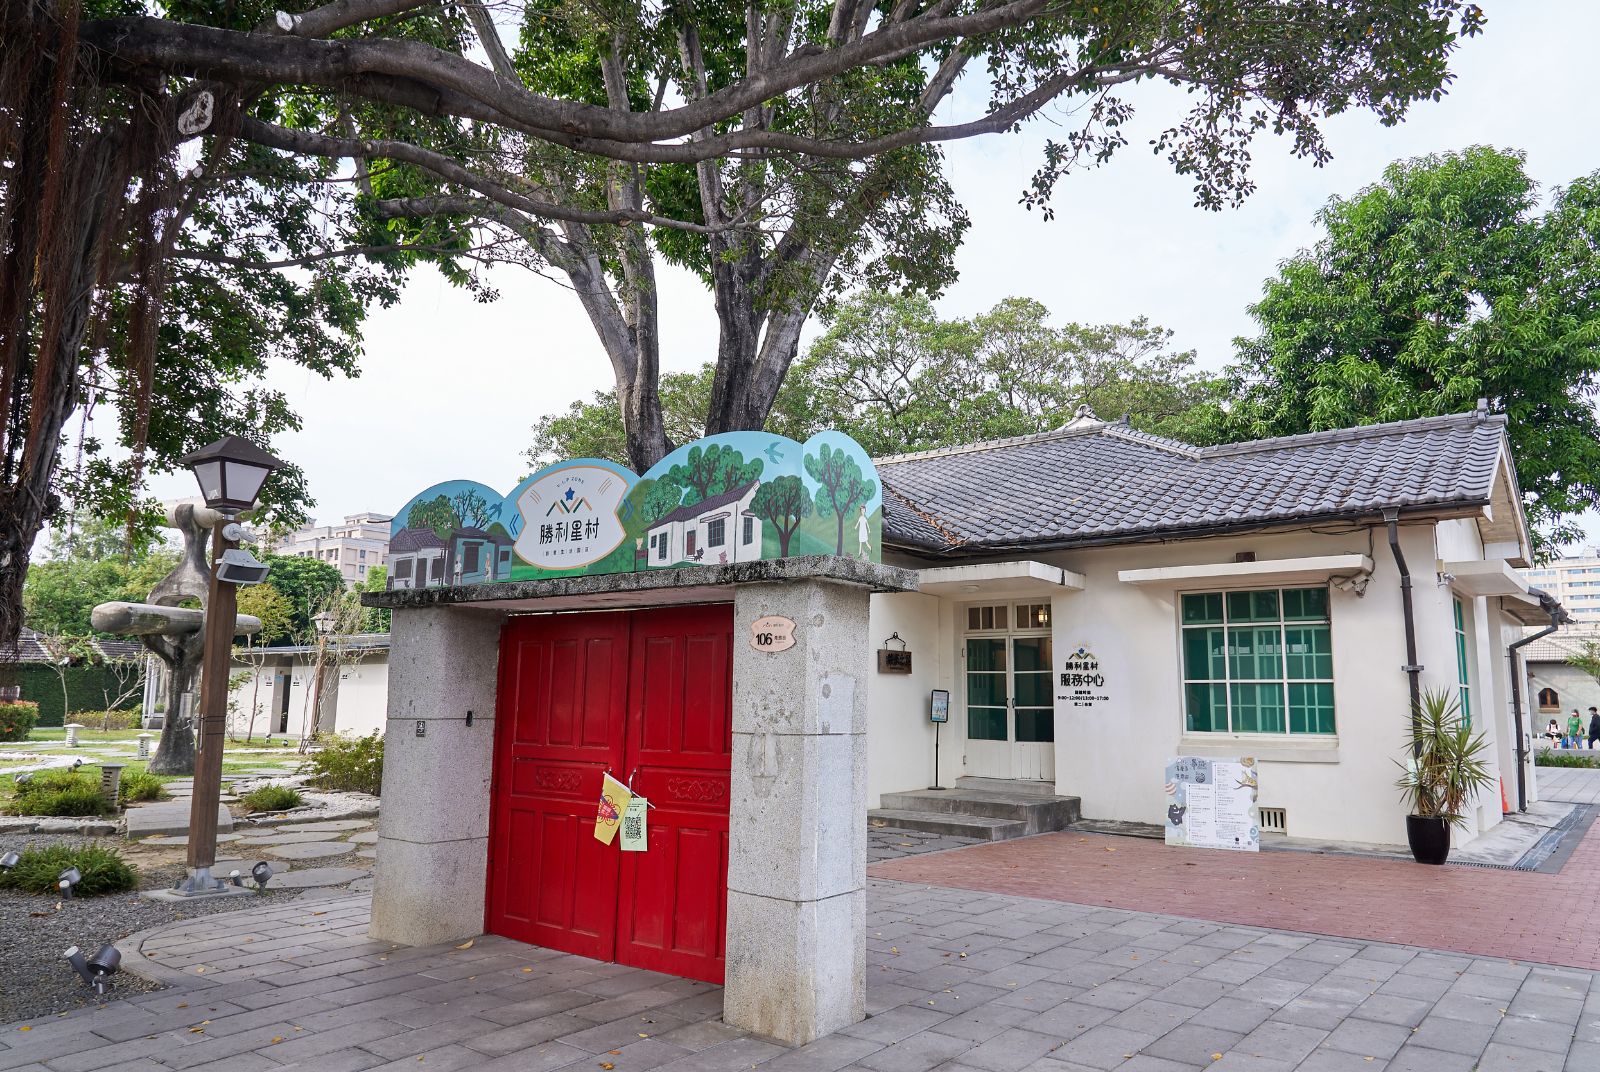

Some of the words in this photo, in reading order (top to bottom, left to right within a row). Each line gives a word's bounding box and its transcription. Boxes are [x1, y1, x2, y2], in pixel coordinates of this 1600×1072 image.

[539, 517, 600, 545] 勝利星村
[755, 632, 773, 646] 106
[1060, 673, 1105, 687] 服務中心
